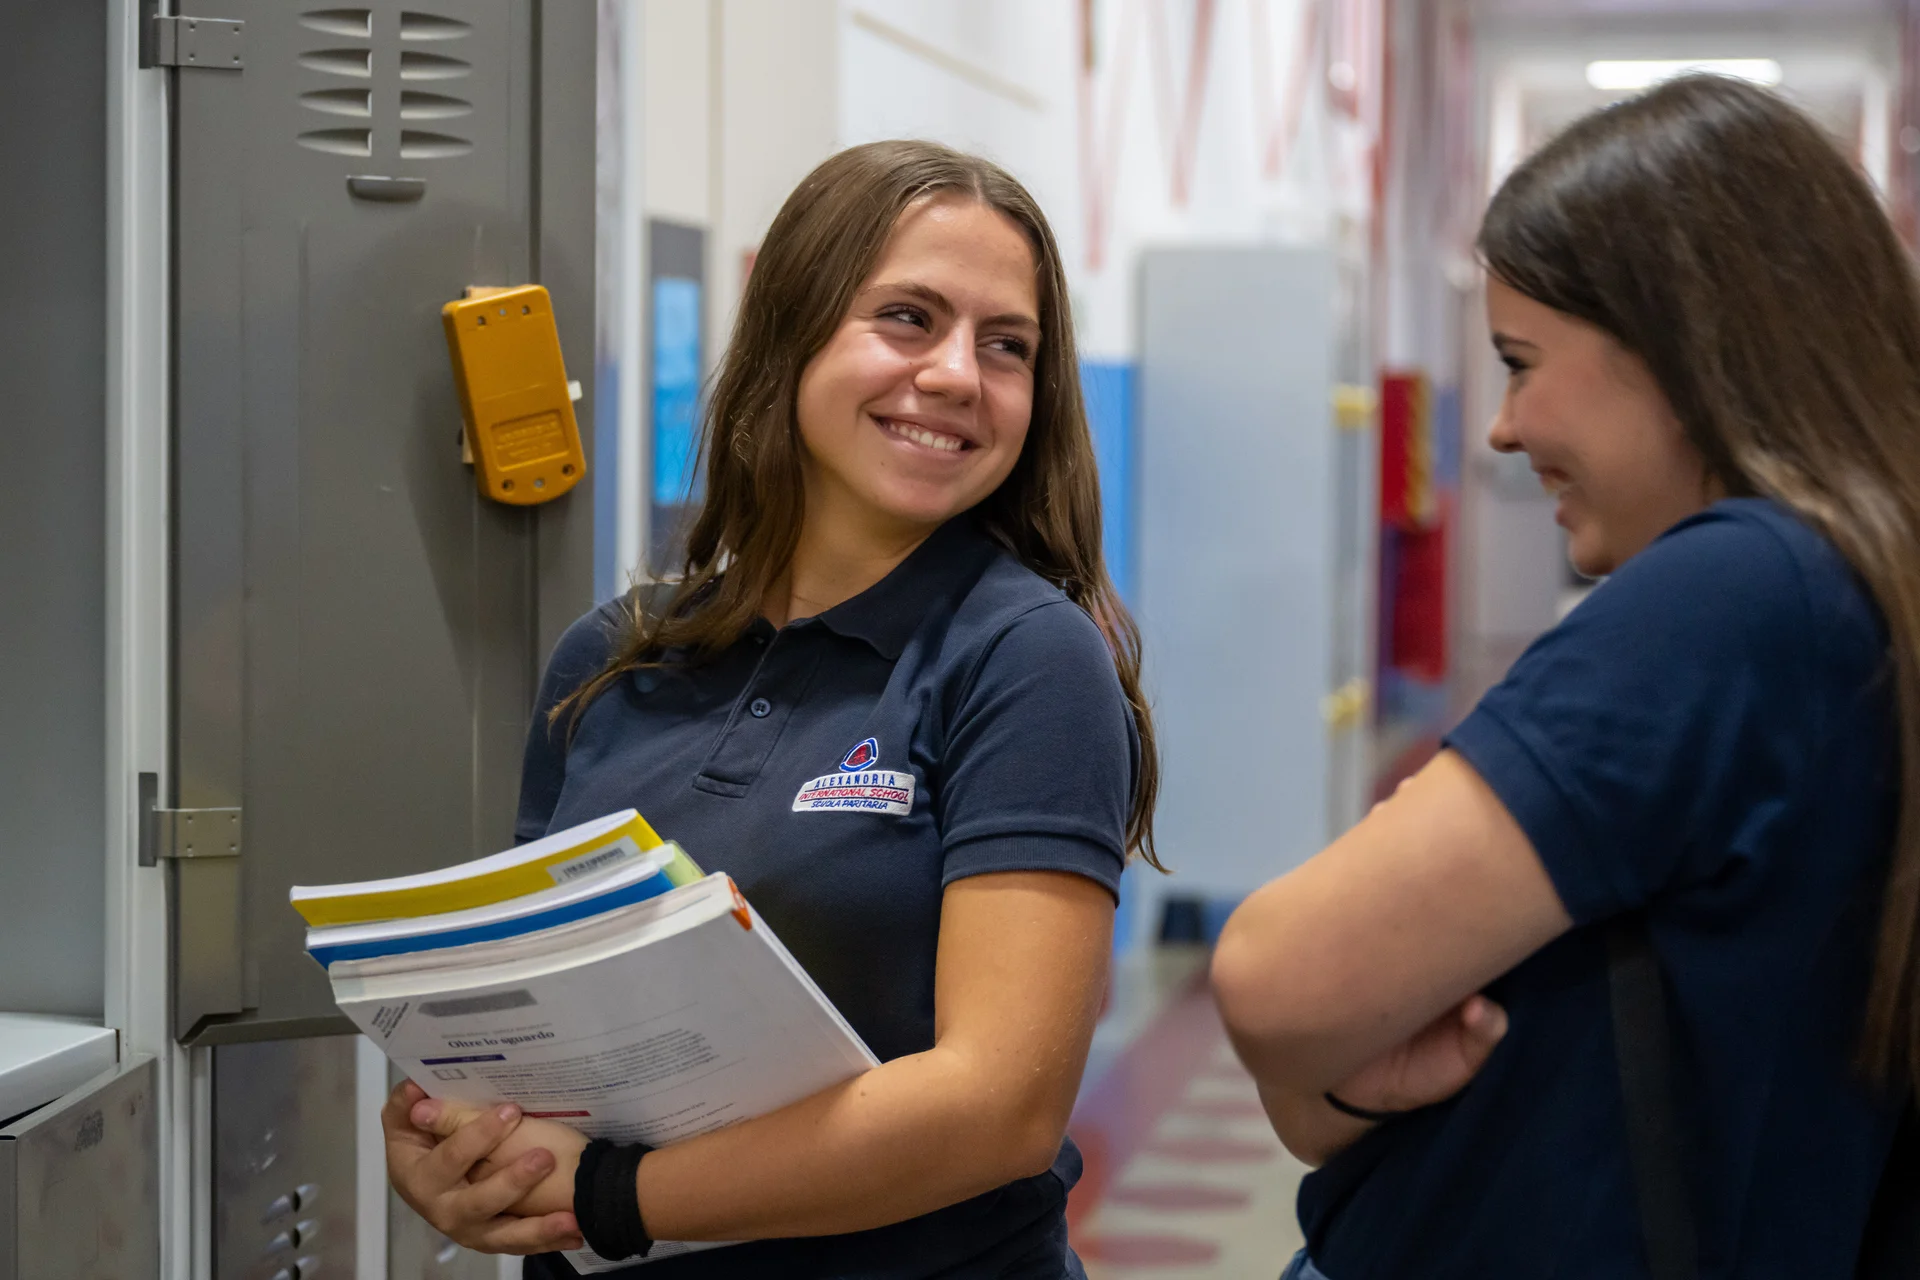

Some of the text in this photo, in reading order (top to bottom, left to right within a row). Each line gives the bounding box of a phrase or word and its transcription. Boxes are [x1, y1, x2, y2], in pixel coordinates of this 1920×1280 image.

[814, 774, 896, 788] ALEXANDRIA
[798, 788, 909, 802] INTERNATIONAL SCHOOL
[811, 799, 888, 810] SCUOLA PARITARIA
[448, 1039, 482, 1049] Oltre
[483, 1035, 499, 1046] lo
[501, 1030, 555, 1046] sguardo
